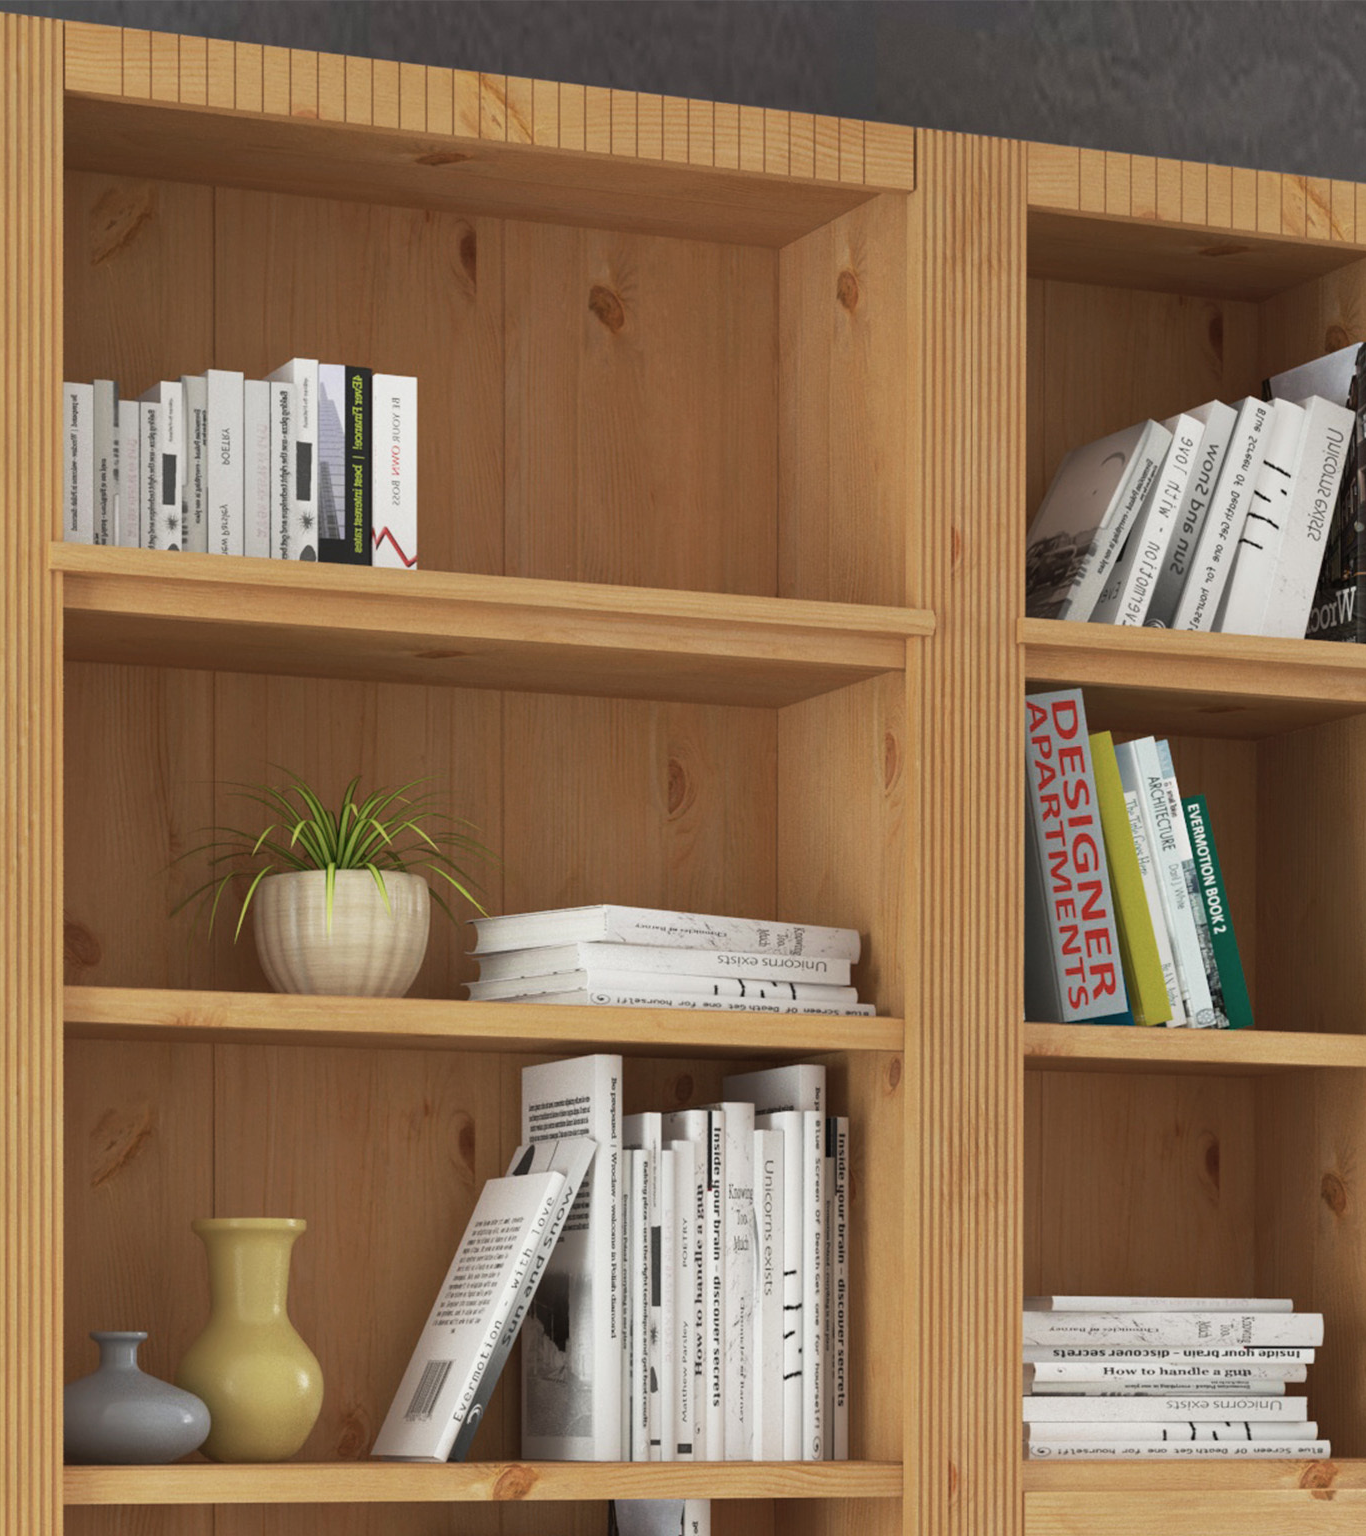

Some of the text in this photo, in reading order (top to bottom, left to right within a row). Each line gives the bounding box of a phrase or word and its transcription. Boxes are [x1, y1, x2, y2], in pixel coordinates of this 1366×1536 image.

[1147, 776, 1176, 852] ARCHITECTURE
[1026, 701, 1089, 1010] APARTMENTS
[1051, 699, 1117, 1000] DESIGNER
[1187, 803, 1227, 935] EVERMOTION BOOK 2
[717, 954, 828, 973] Unicorns exists
[697, 1224, 703, 1235] a
[763, 1159, 775, 1296] Unicorns exists
[501, 1186, 574, 1347] Sun and Snow
[694, 1239, 703, 1304] handle
[710, 1125, 722, 1407] Inside your brain discover secrets
[452, 1196, 555, 1423] Evermotion with love
[695, 1309, 703, 1328] to
[694, 1333, 703, 1376] How
[1053, 1347, 1303, 1359] Inside your brain discover secrets
[1103, 1366, 1137, 1376] How
[1141, 1367, 1156, 1376] to
[1159, 1366, 1210, 1376] handle
[1165, 1399, 1283, 1411] Unicorns exists
